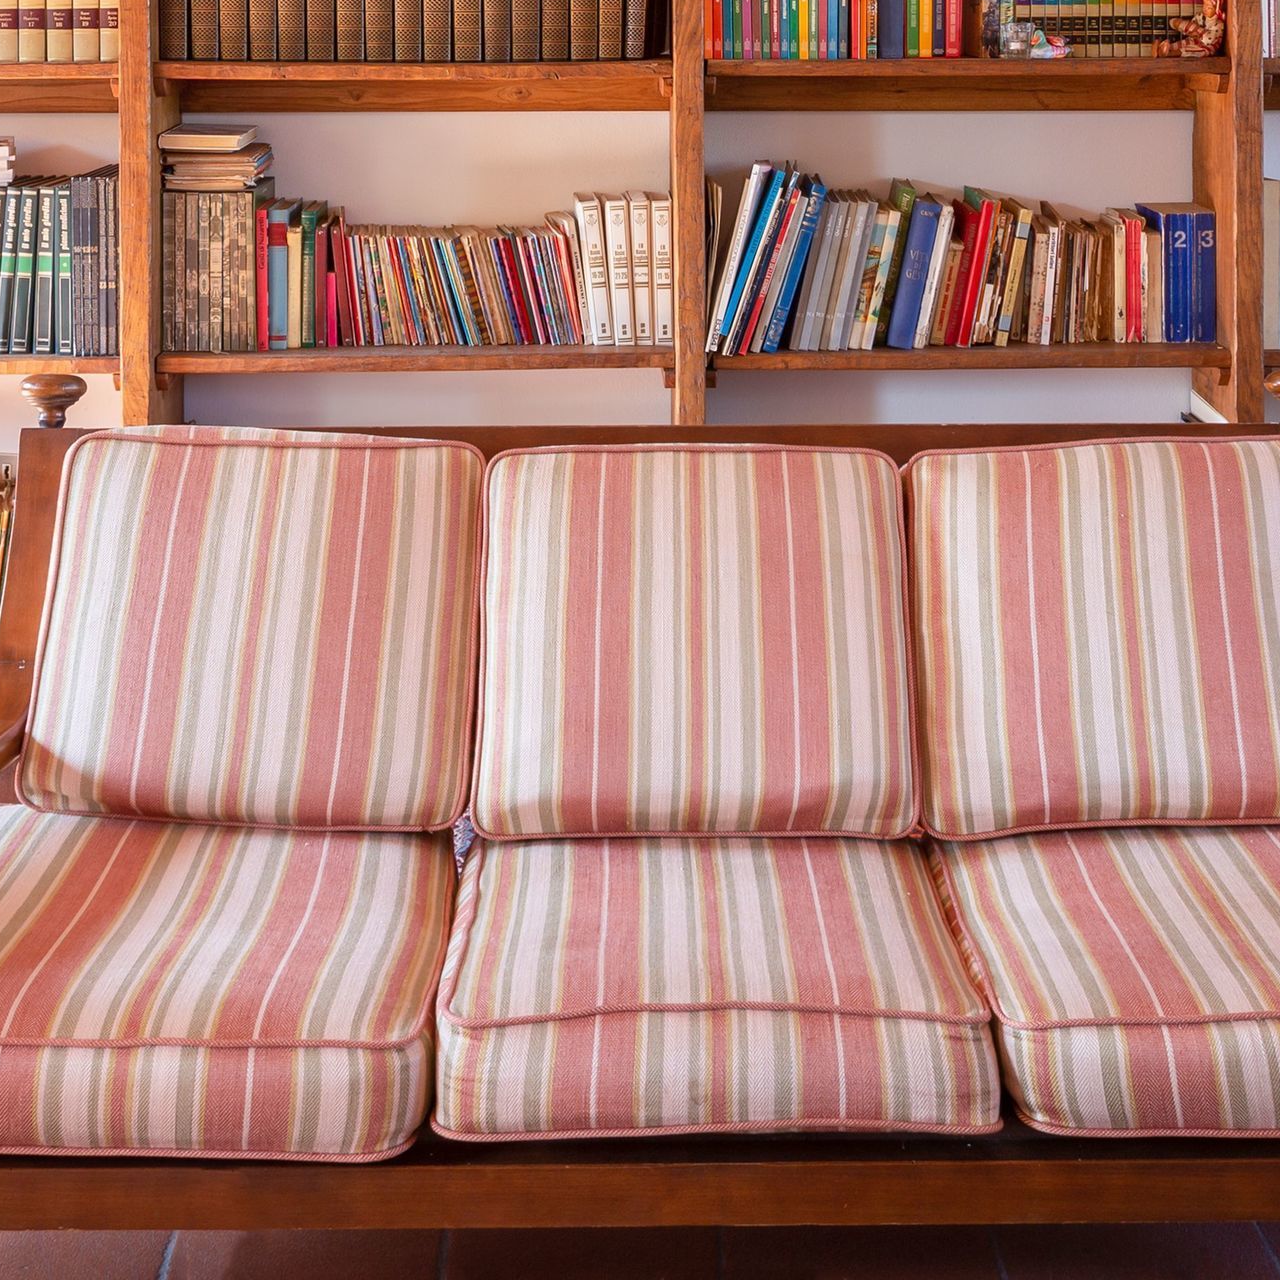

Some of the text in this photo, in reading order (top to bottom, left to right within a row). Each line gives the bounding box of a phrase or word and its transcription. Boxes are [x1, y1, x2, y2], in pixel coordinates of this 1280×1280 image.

[6, 199, 17, 243] mio giardino
[22, 199, 33, 243] mio giardino
[41, 197, 51, 241] mio giardino
[59, 199, 68, 230] medicinali
[1174, 230, 1187, 248] 2
[1201, 230, 1214, 248] 3
